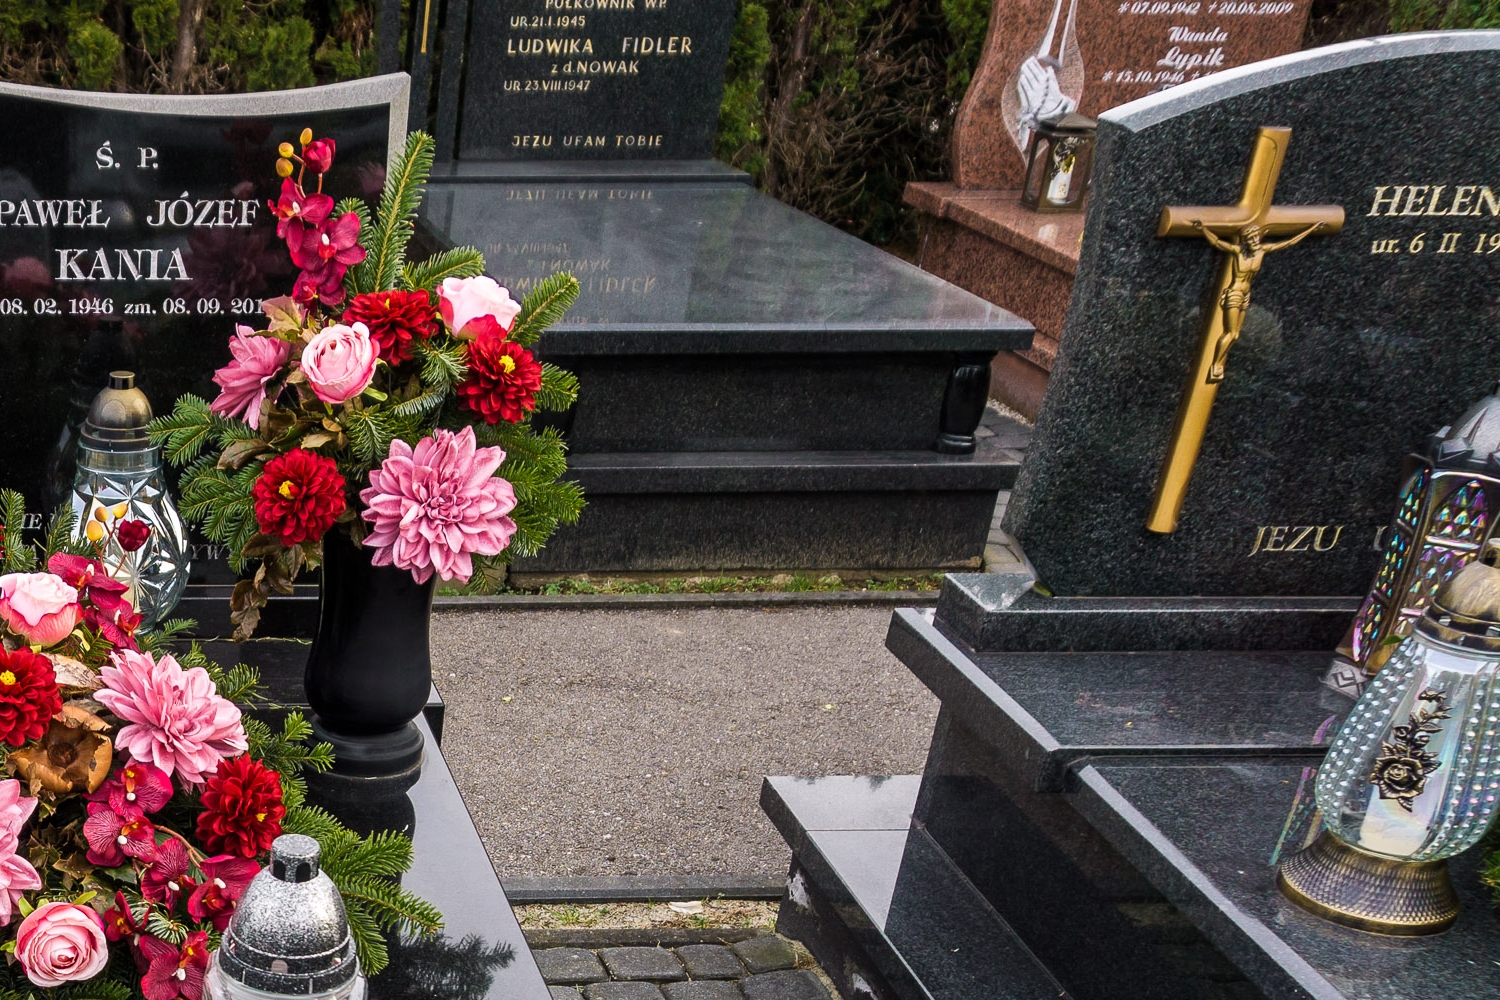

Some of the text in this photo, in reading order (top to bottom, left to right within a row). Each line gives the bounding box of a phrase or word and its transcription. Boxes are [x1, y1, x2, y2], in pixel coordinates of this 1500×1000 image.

[1131, 1, 1294, 15] 07.09.1942 20.08.2009
[1168, 26, 1228, 42] Wanda
[507, 36, 692, 54] LUDWIKA FIDLER
[1156, 46, 1224, 69] Lypik
[1115, 71, 1185, 83] 15.10.1946
[512, 135, 663, 147] JEZU UFAM TOBIE
[137, 147, 158, 168] P.
[146, 190, 260, 228] JÓZEF
[1371, 239, 1400, 254] ur.
[1409, 232, 1426, 254] 6
[1436, 233, 1462, 253] II
[54, 247, 194, 281] KANIA
[0, 298, 27, 315] 08.
[34, 298, 62, 315] 02.
[68, 298, 114, 315] 1946
[124, 303, 156, 315] zm.
[162, 298, 190, 315] 08.
[198, 298, 225, 315] 09.
[231, 298, 265, 315] 201
[1247, 525, 1345, 557] JEZU
